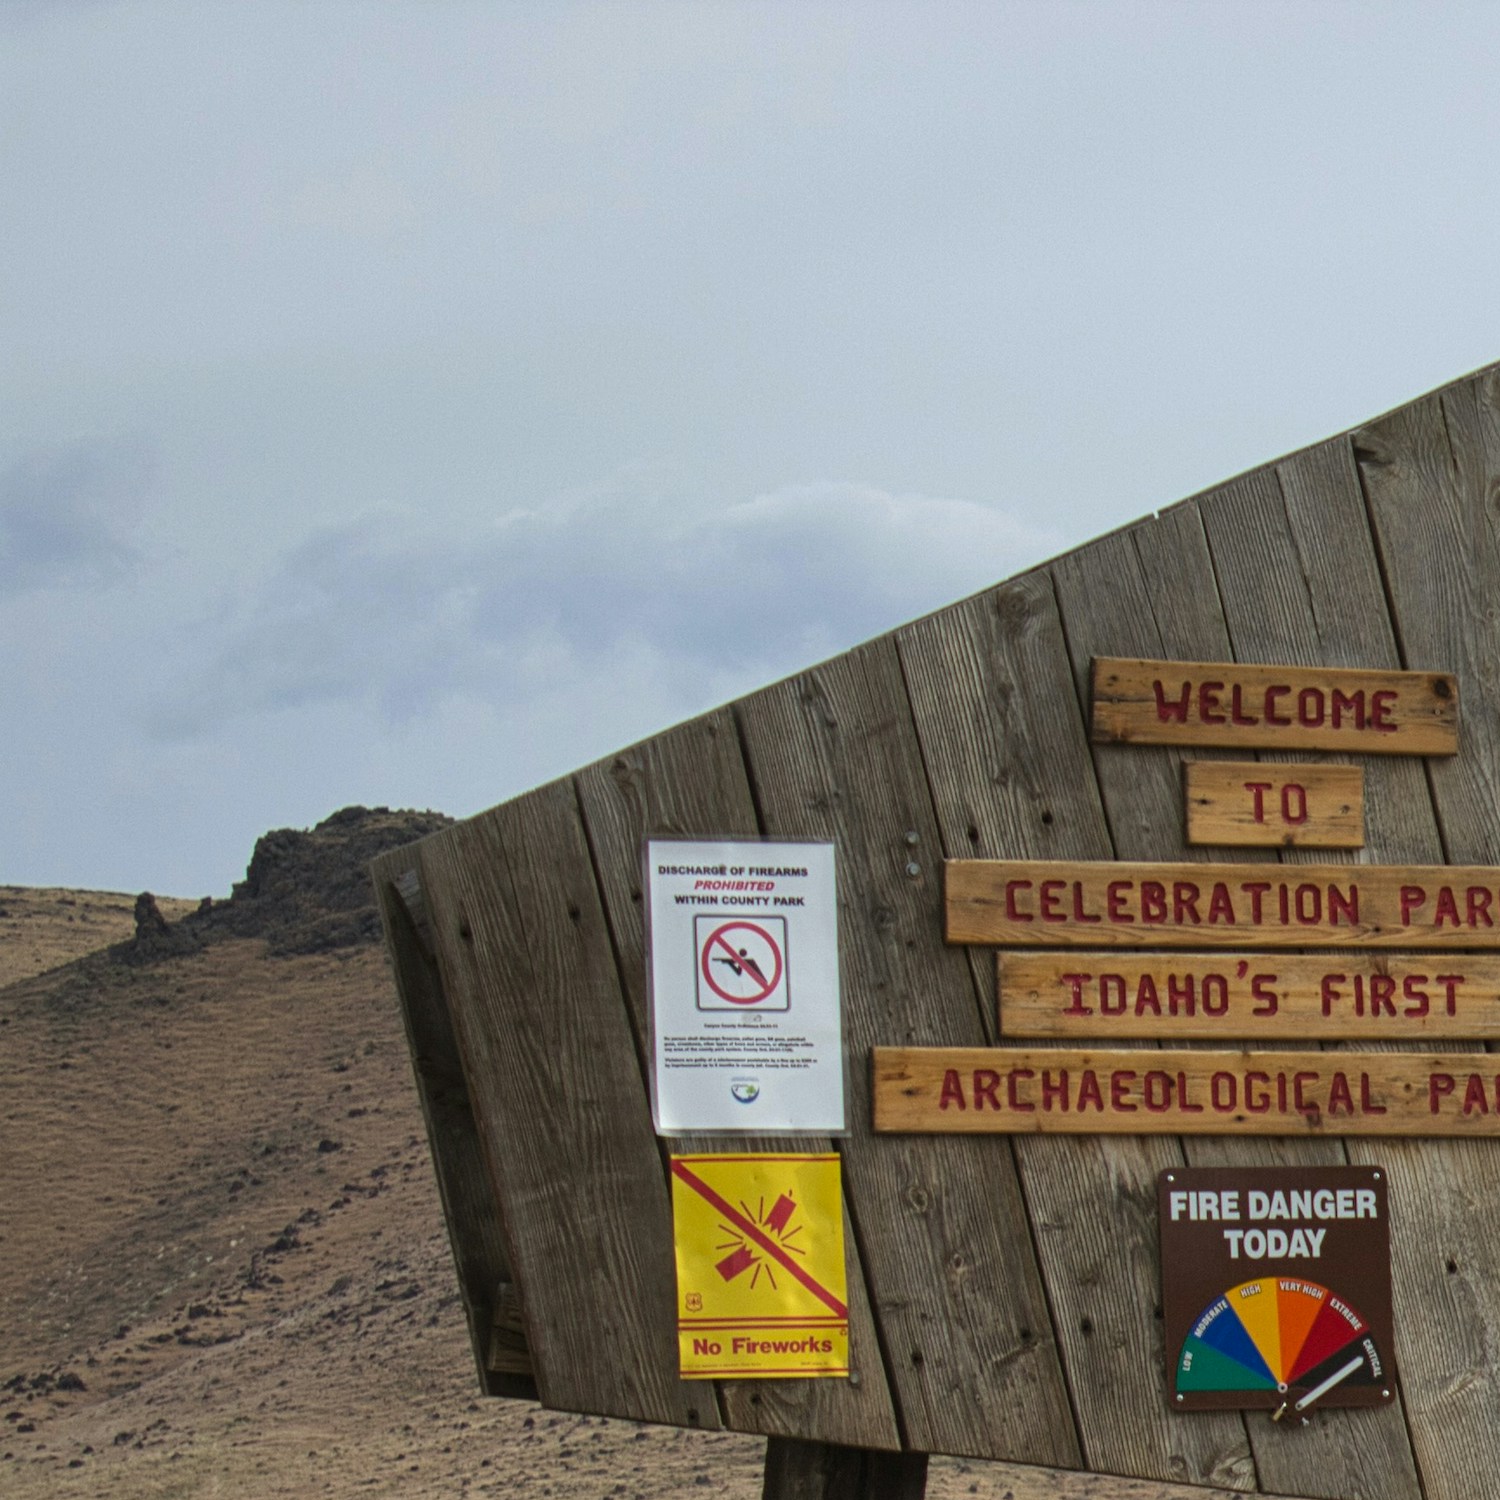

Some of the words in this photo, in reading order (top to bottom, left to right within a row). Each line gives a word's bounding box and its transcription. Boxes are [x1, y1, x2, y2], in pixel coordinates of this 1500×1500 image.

[1153, 680, 1399, 732] WELCOME
[1244, 782, 1309, 825] TO
[658, 865, 727, 876] DISCHARGE
[730, 866, 745, 876] OF
[748, 867, 808, 878] FIREARMS
[694, 880, 775, 892] PROHIBITED
[674, 895, 719, 906] WITHIN
[721, 895, 770, 906] COUNTY
[774, 896, 805, 907] PARK
[1005, 880, 1361, 927] CELEBRATION
[1061, 960, 1279, 1018] IDAHO'S
[1321, 974, 1466, 1018] FIRST
[939, 1069, 1387, 1116] ARCHAEOLOGICAL
[1169, 1191, 1241, 1221] FIRE
[1248, 1189, 1378, 1220] DANGER
[1223, 1228, 1327, 1259] TODAY
[1240, 1283, 1262, 1298] HIGH
[1280, 1280, 1302, 1291] VERY
[1302, 1285, 1324, 1300] HIGH
[1194, 1299, 1229, 1338] MODERATE
[1329, 1297, 1363, 1331] EXTREME
[692, 1338, 722, 1355] No
[732, 1335, 833, 1354] Fireworks
[1182, 1350, 1193, 1371] LOW
[1362, 1338, 1382, 1378] CRITICAL
